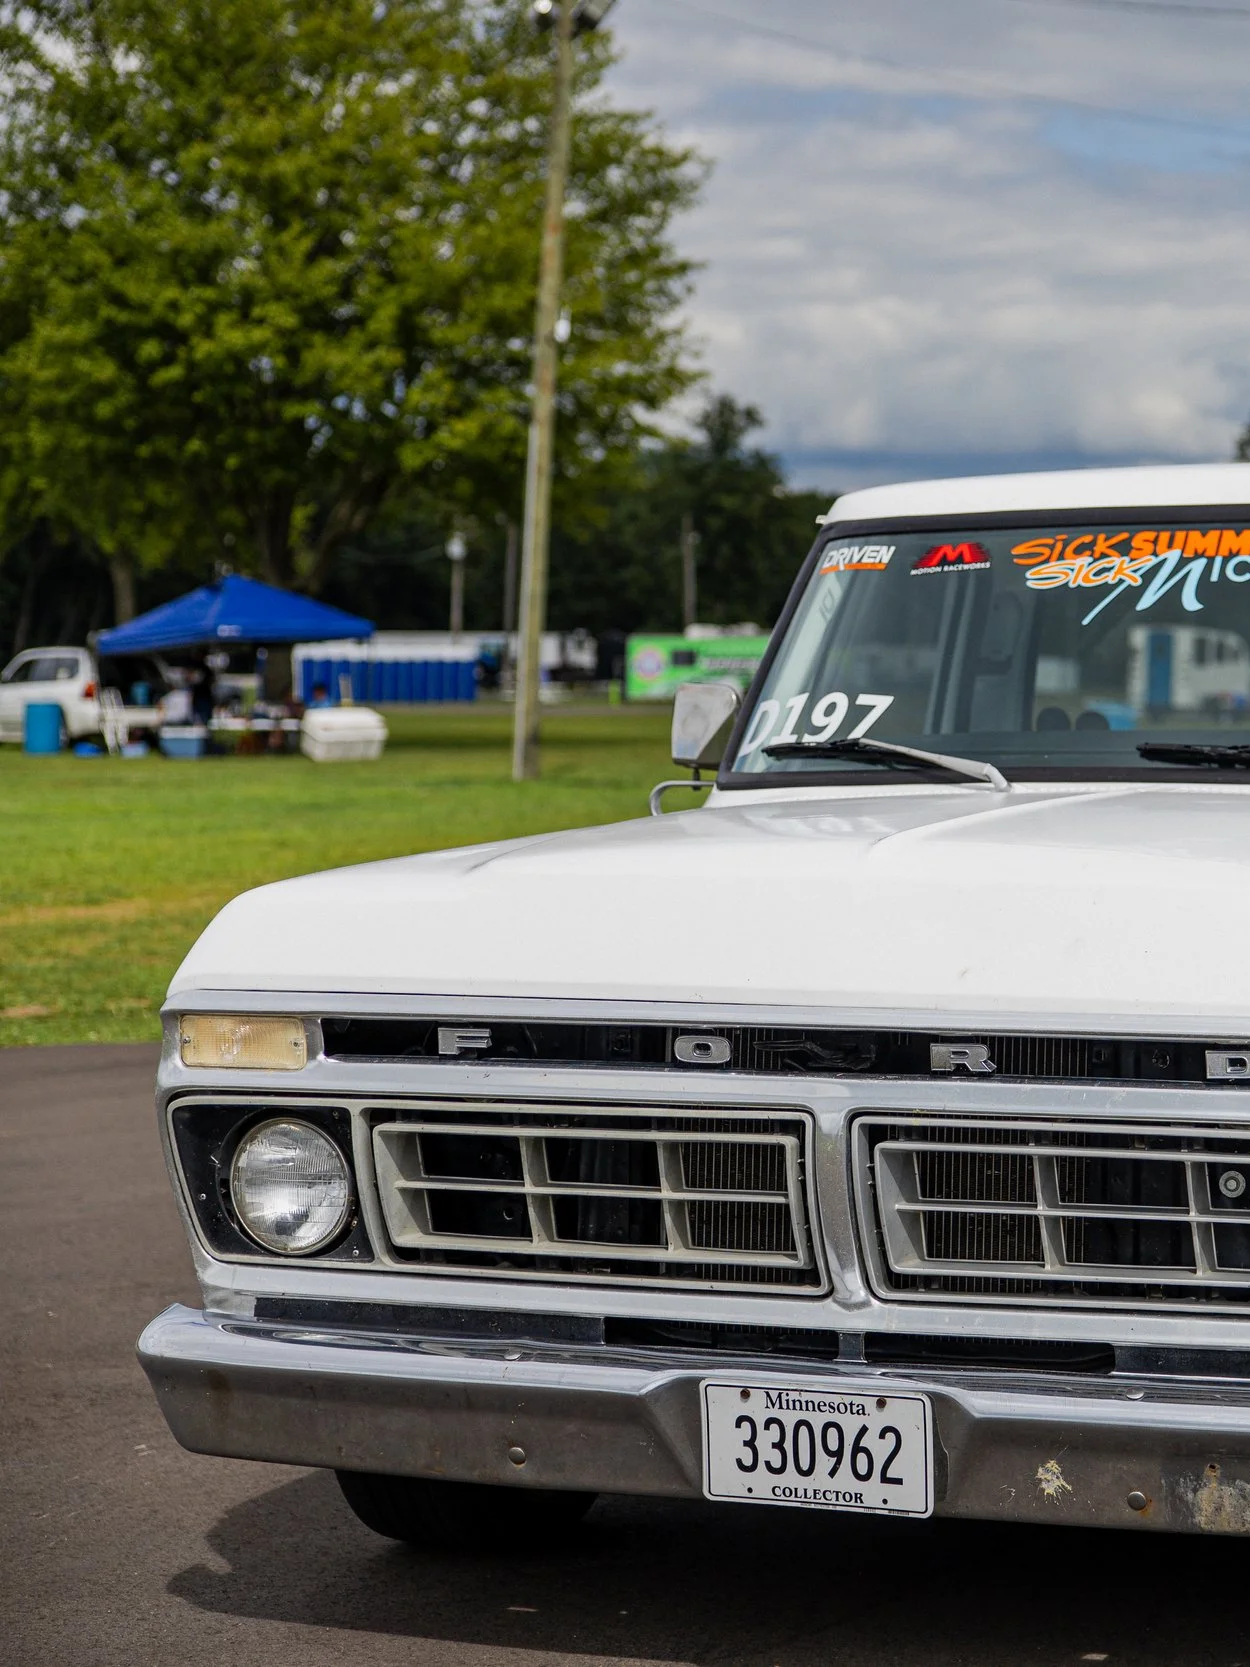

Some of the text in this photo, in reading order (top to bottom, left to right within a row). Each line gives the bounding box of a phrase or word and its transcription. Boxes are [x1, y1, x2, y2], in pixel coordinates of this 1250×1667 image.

[822, 545, 896, 571] DRIVEN
[735, 1414, 904, 1486] 330962
[771, 1485, 865, 1504] COLLECTOR
